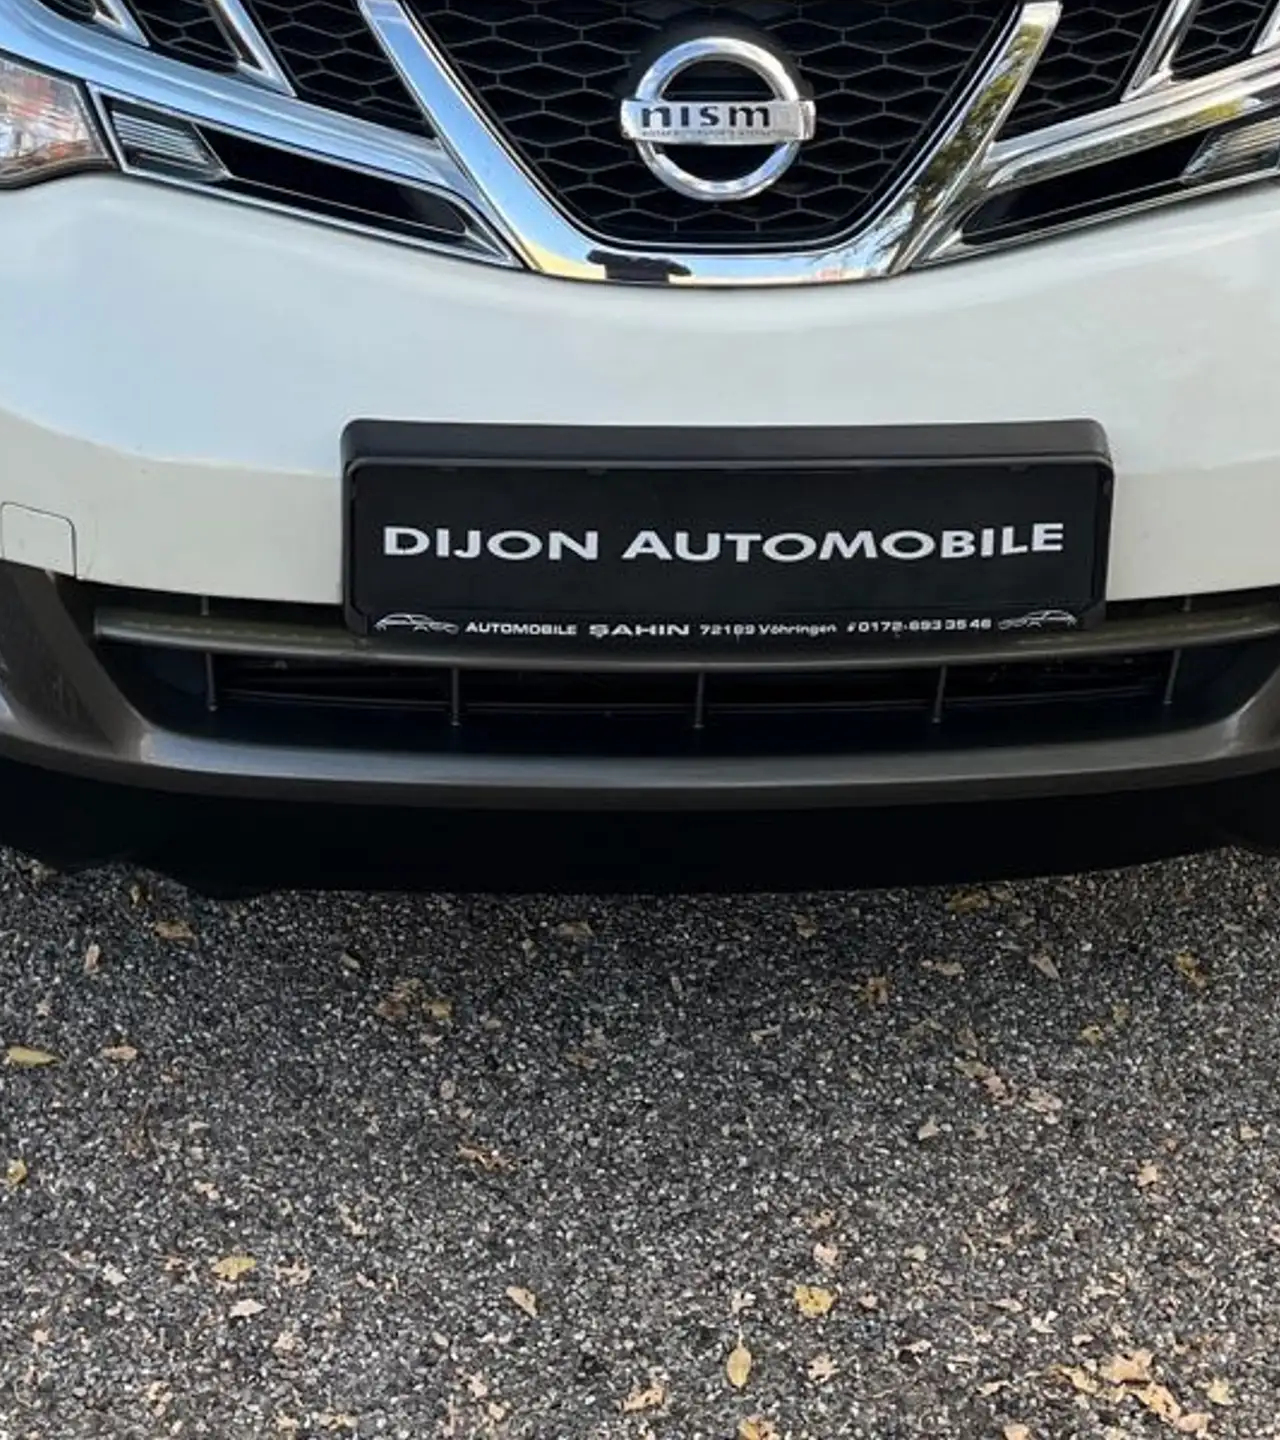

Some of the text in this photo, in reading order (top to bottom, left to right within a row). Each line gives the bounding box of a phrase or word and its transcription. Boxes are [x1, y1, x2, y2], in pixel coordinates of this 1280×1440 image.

[641, 105, 770, 128] nism
[383, 522, 1064, 563] DIJON AUTOMOBILE
[464, 622, 578, 636] AUTOMOBILE
